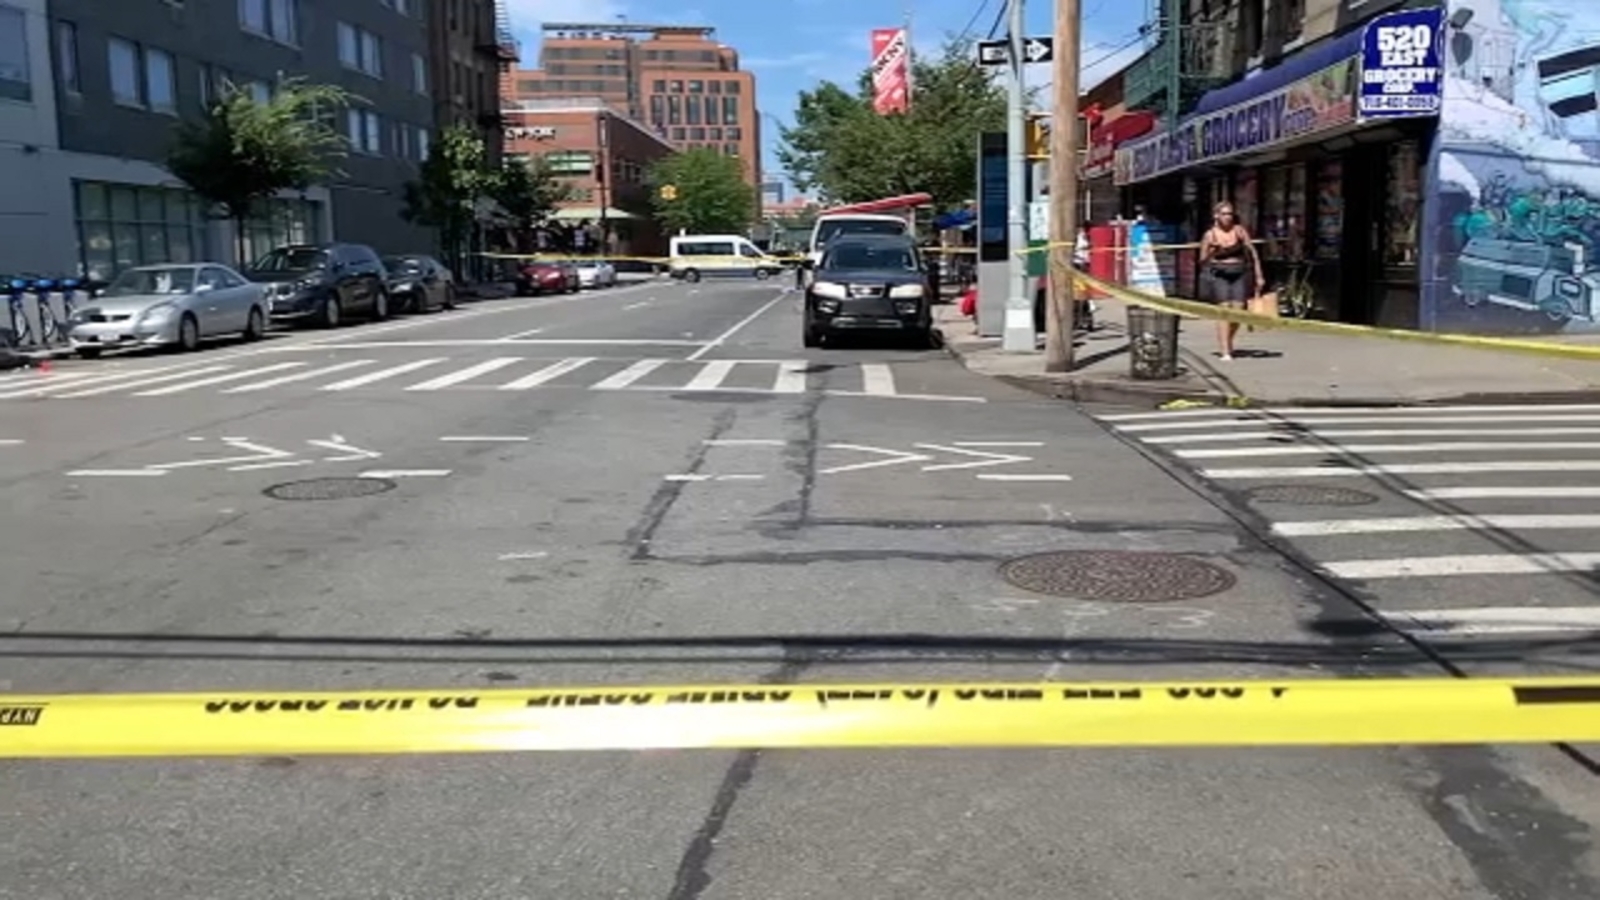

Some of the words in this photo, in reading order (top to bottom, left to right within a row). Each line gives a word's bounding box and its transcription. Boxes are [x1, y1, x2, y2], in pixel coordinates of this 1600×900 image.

[1378, 25, 1430, 50] 520
[1382, 50, 1427, 66] EAST
[1364, 67, 1436, 83] GROCERY
[1203, 95, 1285, 157] GROCERY
